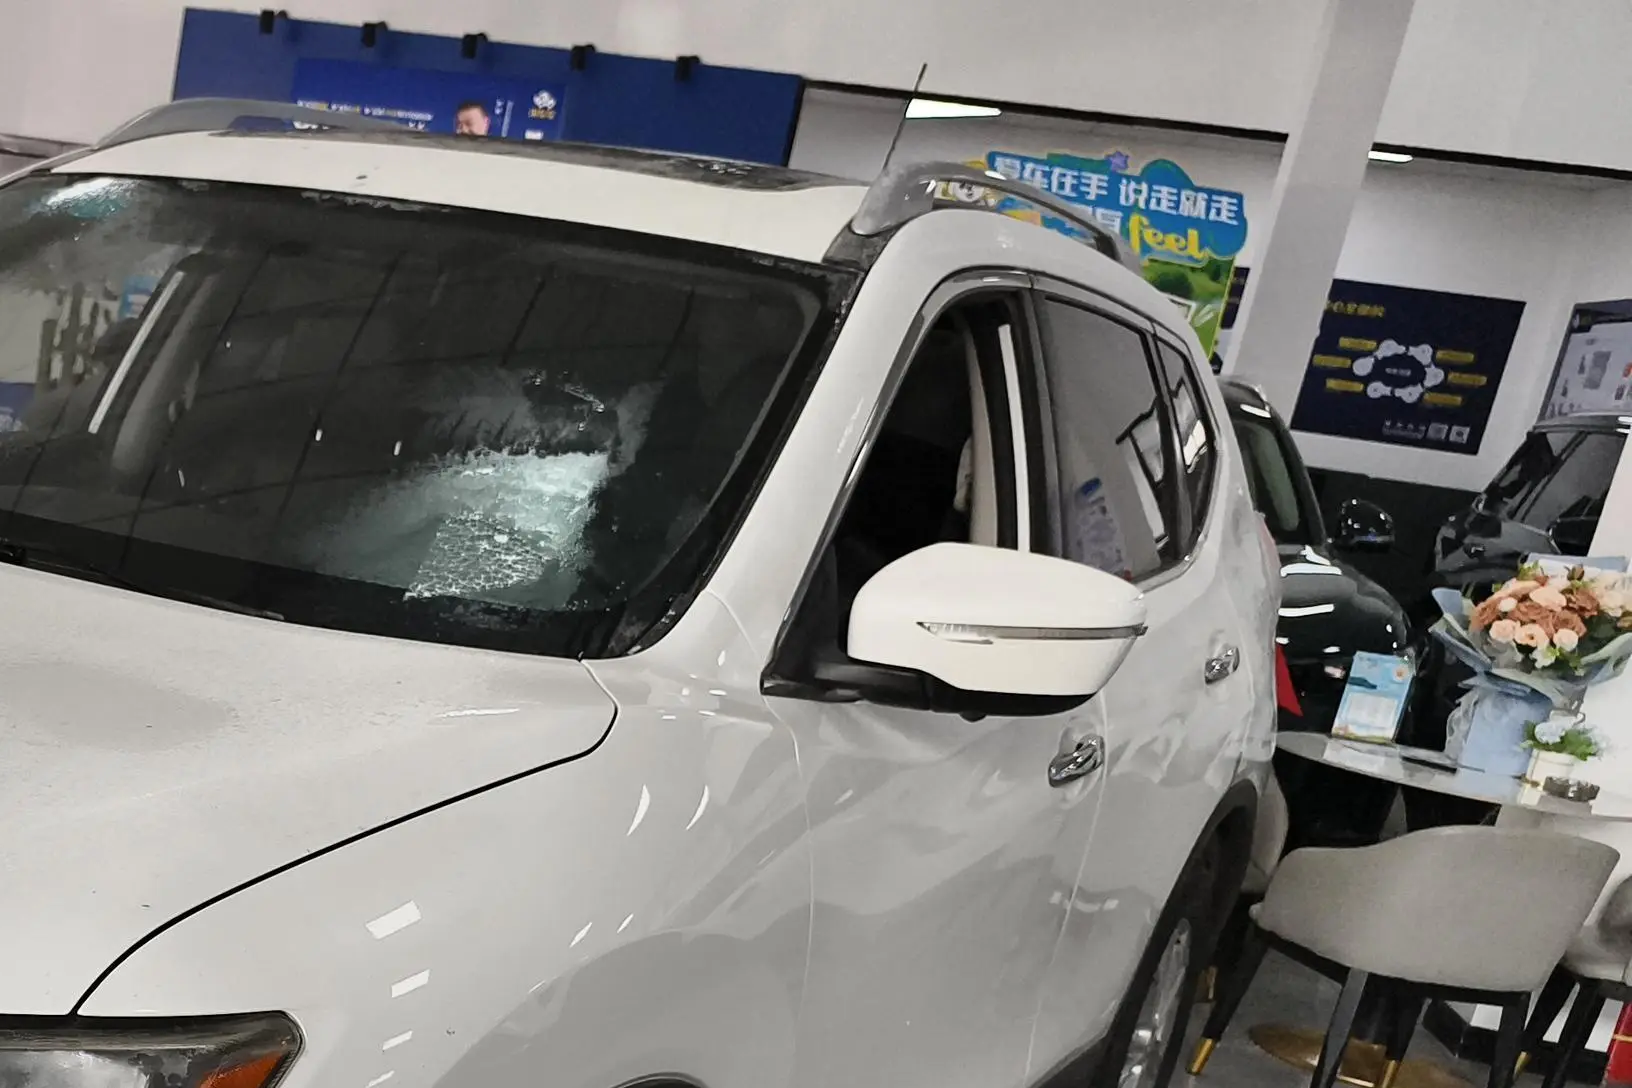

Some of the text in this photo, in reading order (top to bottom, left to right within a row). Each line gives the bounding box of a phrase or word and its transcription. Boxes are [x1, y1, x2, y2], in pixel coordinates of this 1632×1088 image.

[1119, 178, 1239, 226] 说走就走
[1129, 212, 1206, 258] feel
